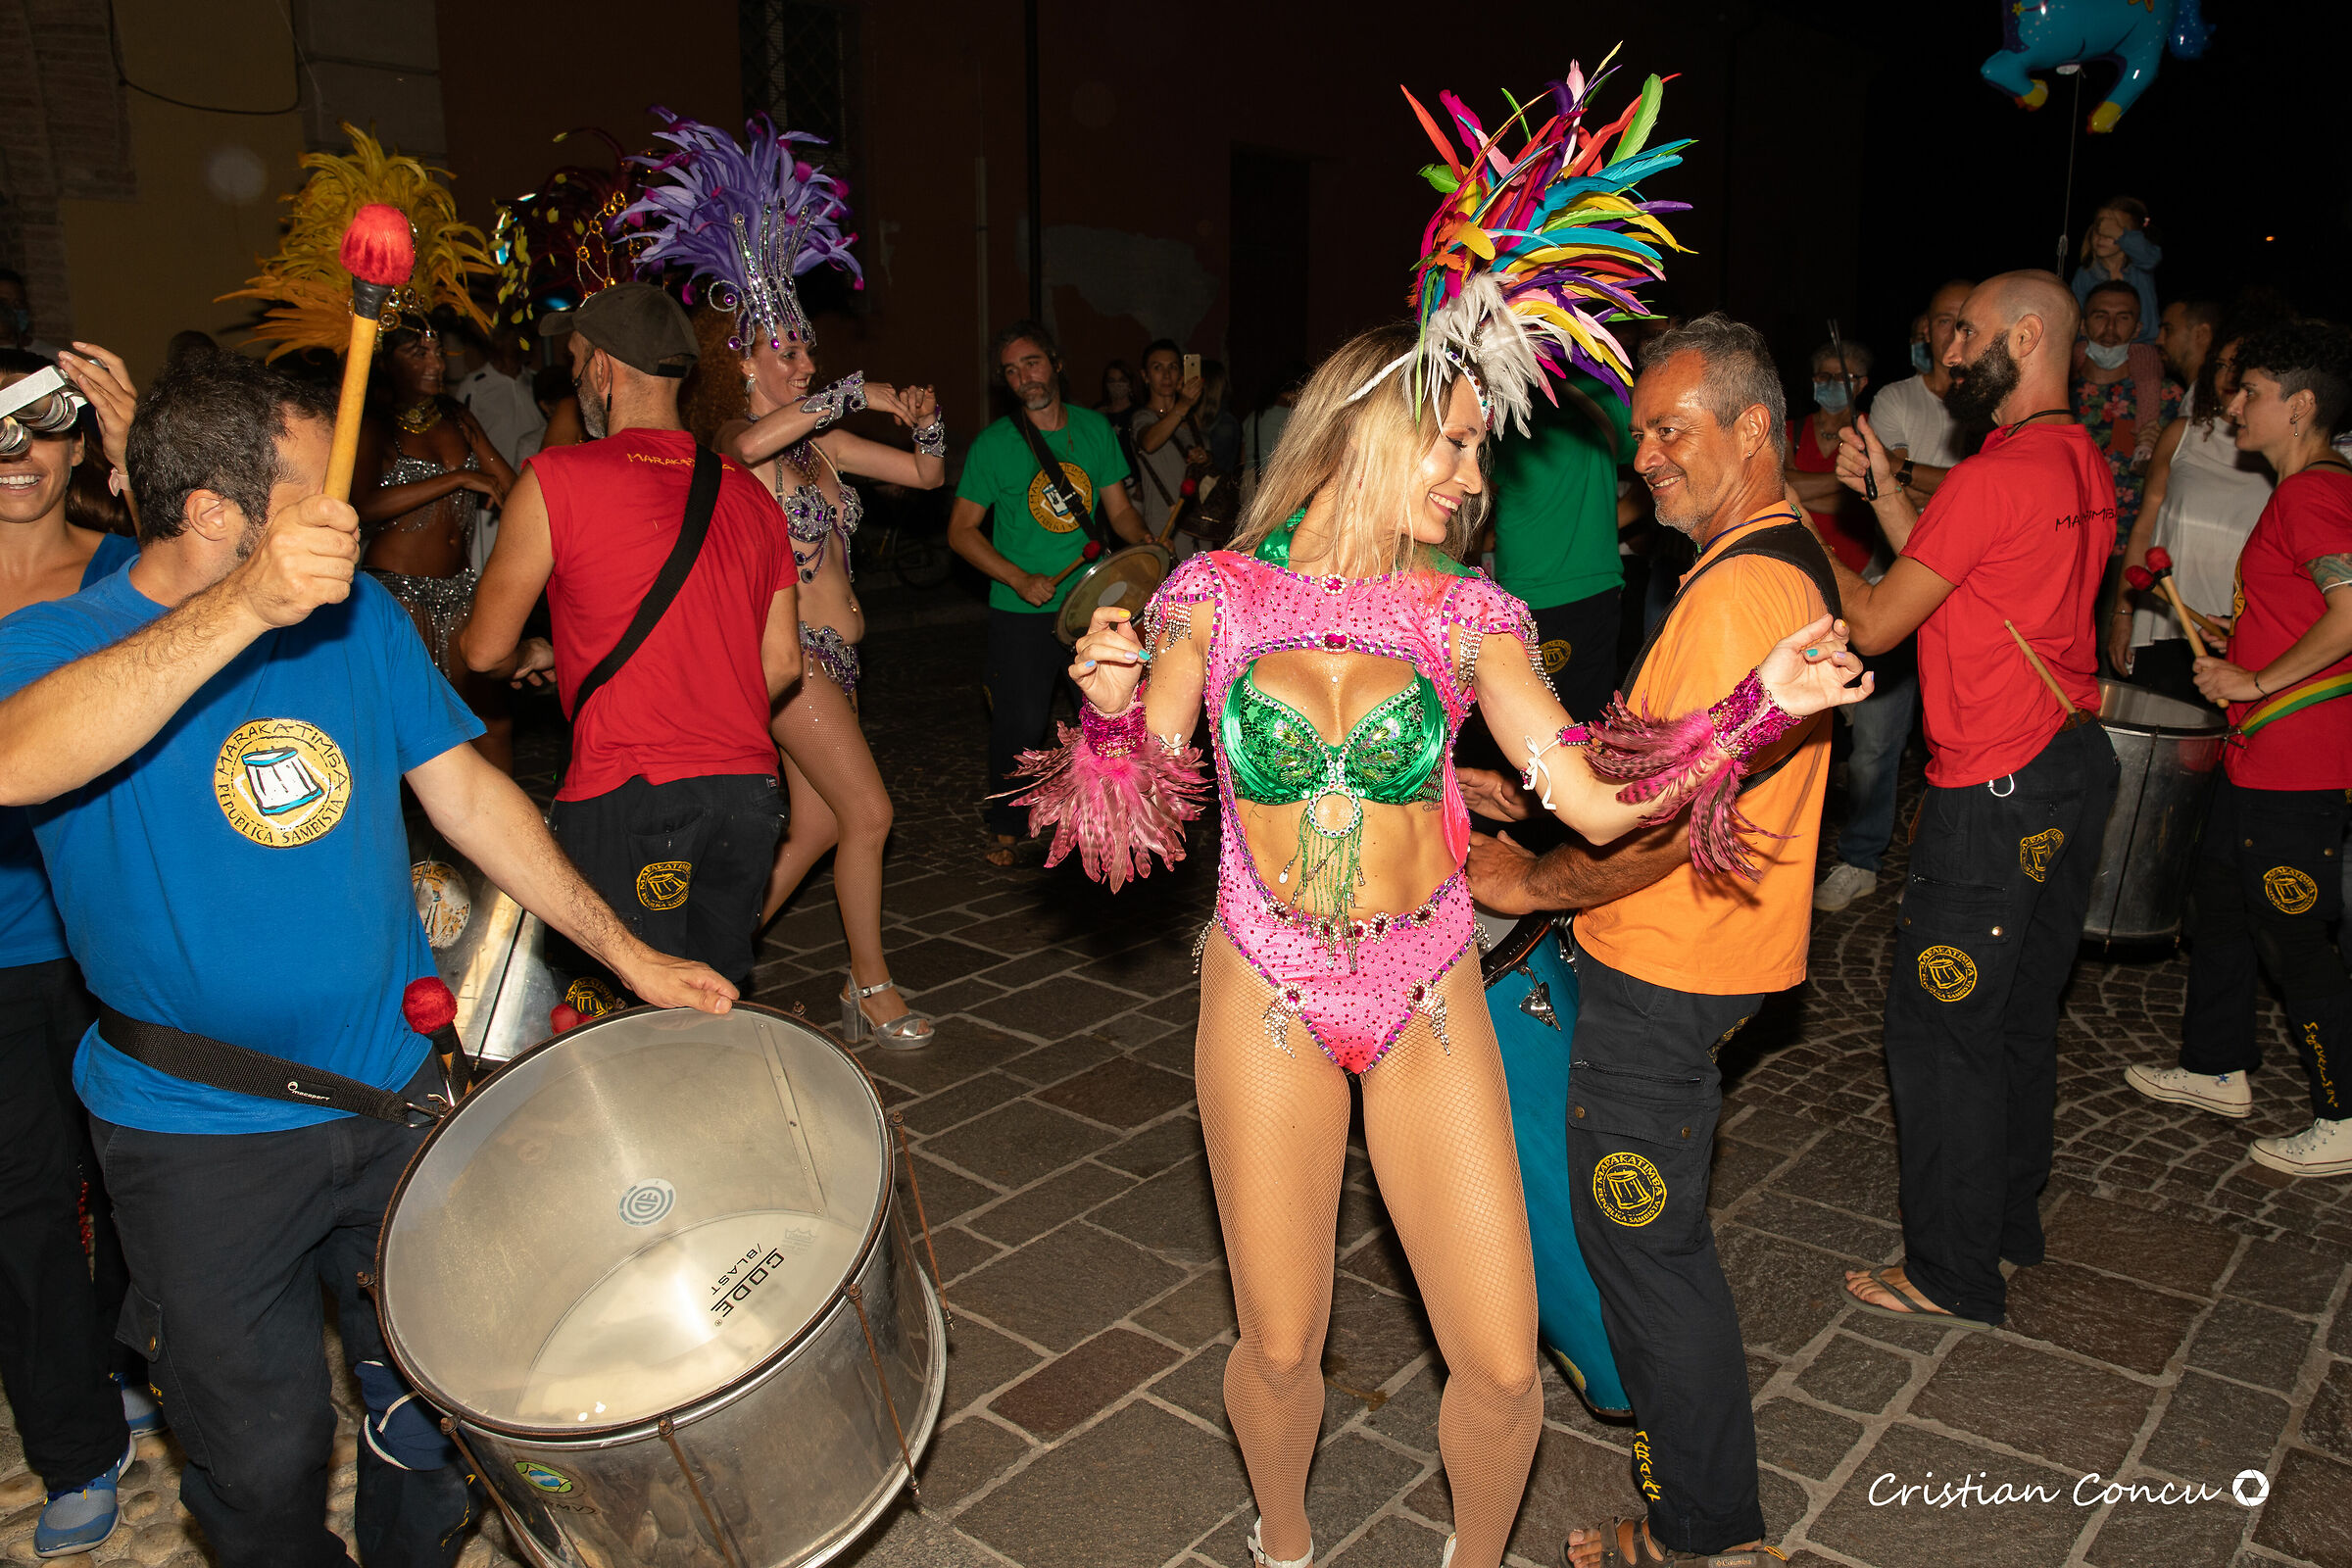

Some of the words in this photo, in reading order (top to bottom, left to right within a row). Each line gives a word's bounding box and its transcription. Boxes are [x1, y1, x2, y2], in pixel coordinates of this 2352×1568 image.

[217, 723, 349, 792] MARAKATIMBA
[218, 783, 273, 844] REPUBLICA
[281, 799, 344, 844] SAMBISTA
[1596, 1154, 1663, 1197] MARAKATIMBA
[1597, 1187, 1627, 1222] REPUBLICA
[1629, 1200, 1661, 1223] SAMBISTA
[715, 1251, 785, 1318] CODE
